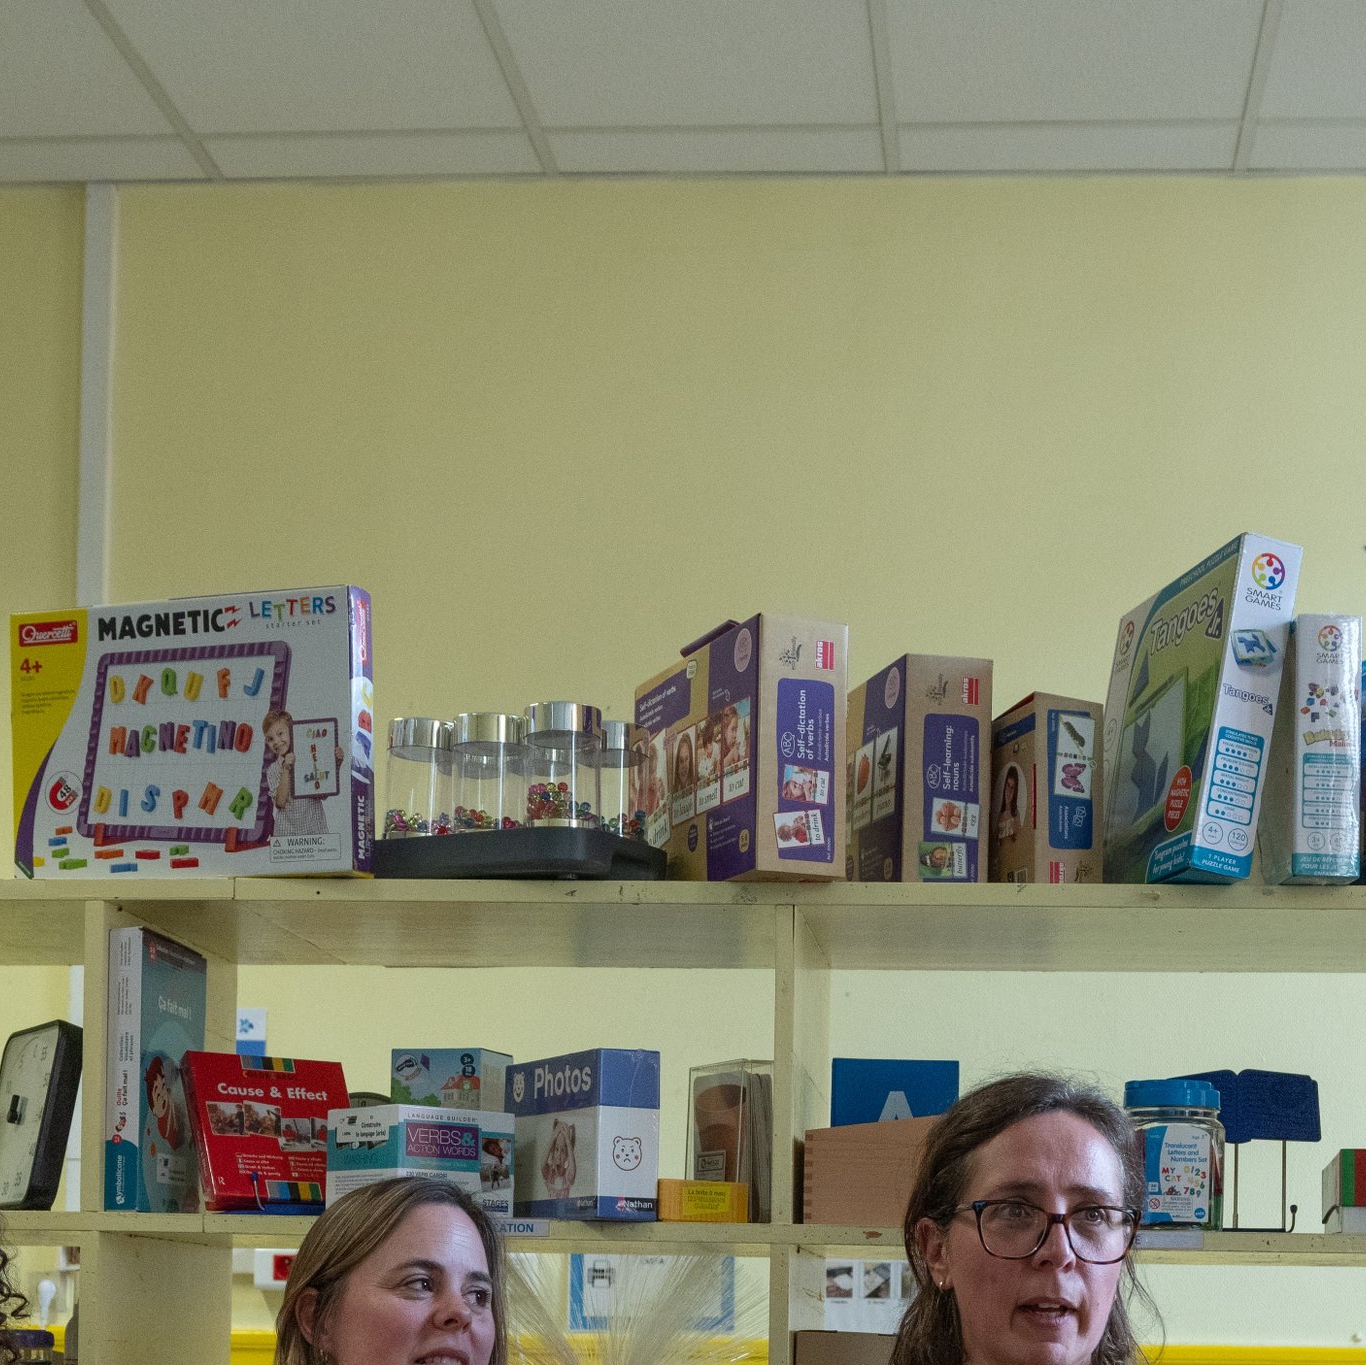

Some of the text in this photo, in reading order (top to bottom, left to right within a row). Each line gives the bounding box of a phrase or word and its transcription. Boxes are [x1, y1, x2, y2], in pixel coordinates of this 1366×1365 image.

[1245, 595, 1282, 611] GAMES
[1247, 587, 1283, 603] SMART
[98, 596, 337, 641] MAGNETIC LETTERS
[1150, 587, 1218, 656] Tangoes
[21, 624, 73, 643] Quercetti
[20, 658, 43, 674] 4+
[961, 677, 969, 704] akros
[1223, 683, 1270, 706] Tangoes
[797, 689, 807, 759] Self-dictation
[109, 720, 253, 757] MAGNETINO
[782, 734, 793, 755] ABC
[806, 718, 814, 760] of verbs
[942, 725, 953, 790] Self-learning:
[59, 784, 71, 799] 48
[357, 795, 366, 860] MAGNETIC
[810, 812, 821, 842] to drink
[1208, 825, 1218, 834] 4+
[287, 836, 325, 847] WARNING:
[1231, 832, 1246, 842] 120
[955, 845, 964, 874] butterfly
[1202, 859, 1240, 873] PUZZLE GAME
[1213, 855, 1237, 865] PLAYER
[217, 1082, 328, 1101] Cause & Effect
[534, 1065, 592, 1099] Photos
[407, 1112, 444, 1121] LANGUAGE
[407, 1127, 461, 1146] VERBS
[407, 1145, 475, 1157] ACTION WORDS
[1170, 1155, 1196, 1163] Numbers
[482, 1198, 509, 1207] STAGES
[624, 1200, 653, 1209] Nathan
[494, 1223, 534, 1234] CATION
